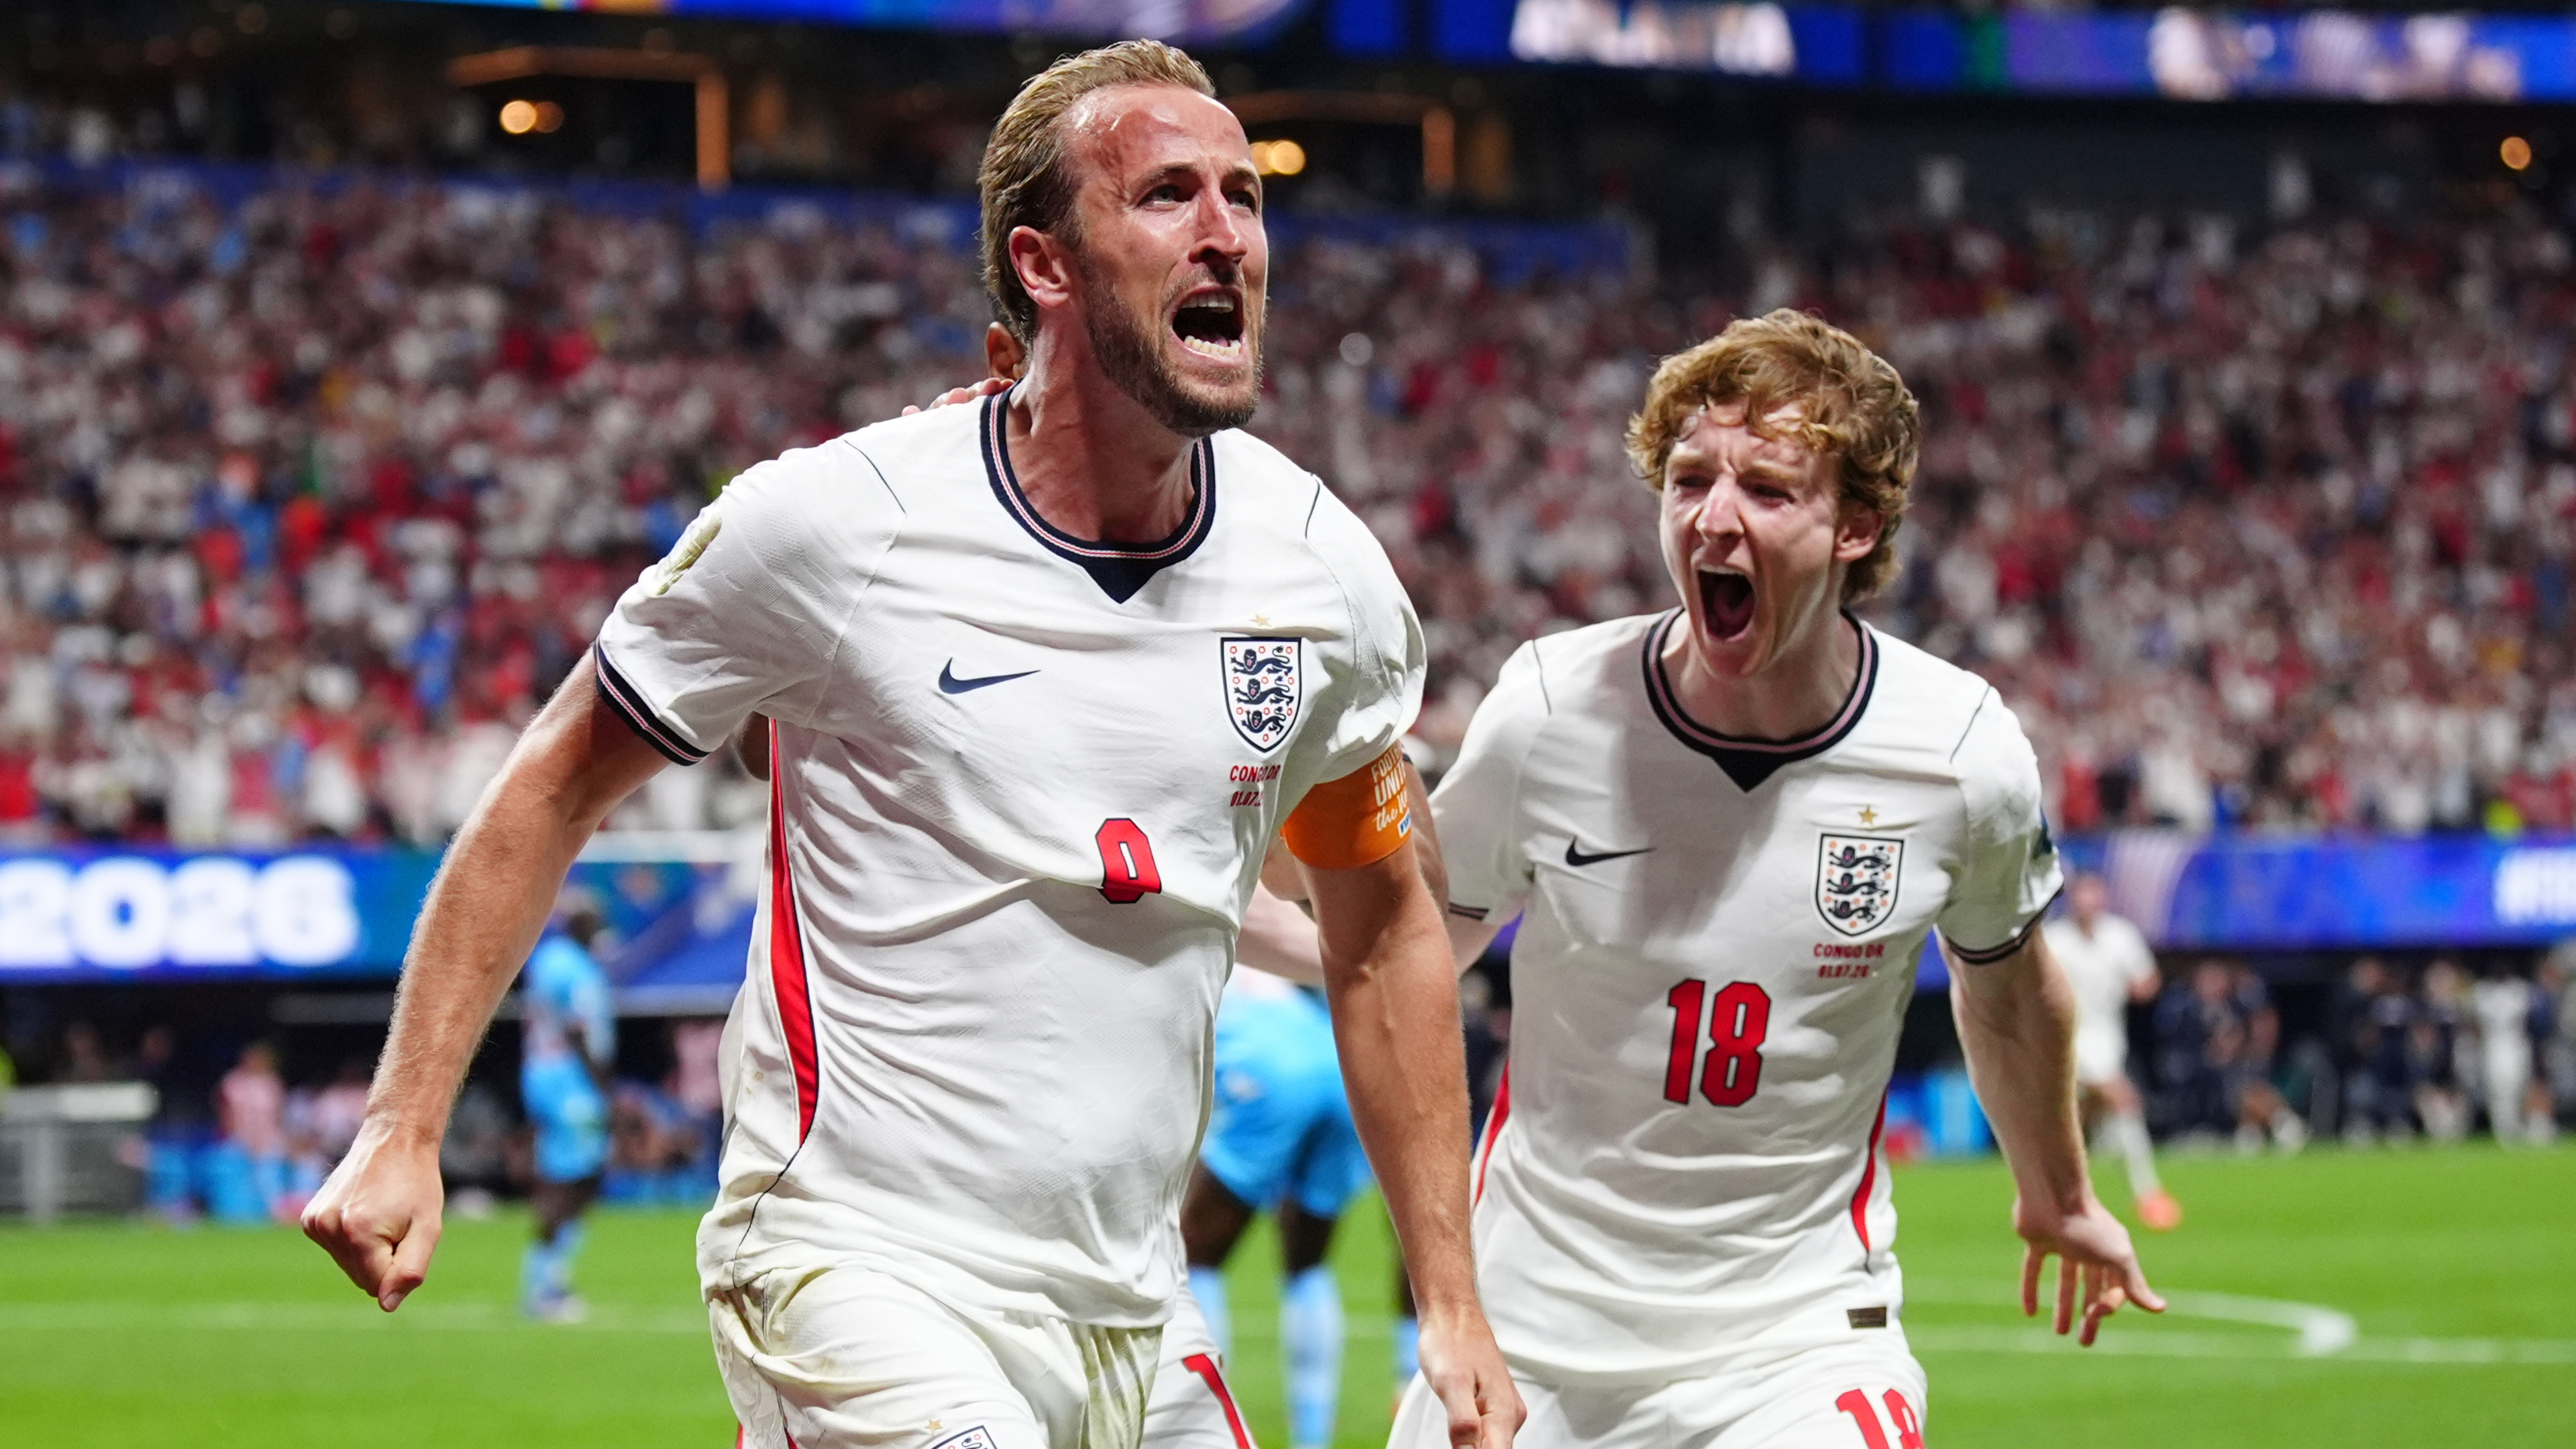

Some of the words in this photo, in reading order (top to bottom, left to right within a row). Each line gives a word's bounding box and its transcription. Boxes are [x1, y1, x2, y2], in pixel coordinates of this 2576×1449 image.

[1230, 765, 1268, 782] CONGO
[1265, 764, 1281, 780] DR
[1372, 806, 1399, 832] the
[0, 856, 359, 968] 2026
[1813, 943, 1864, 959] CONGO
[1664, 978, 1770, 1107] 18
[1835, 1388, 1925, 1449] 18
